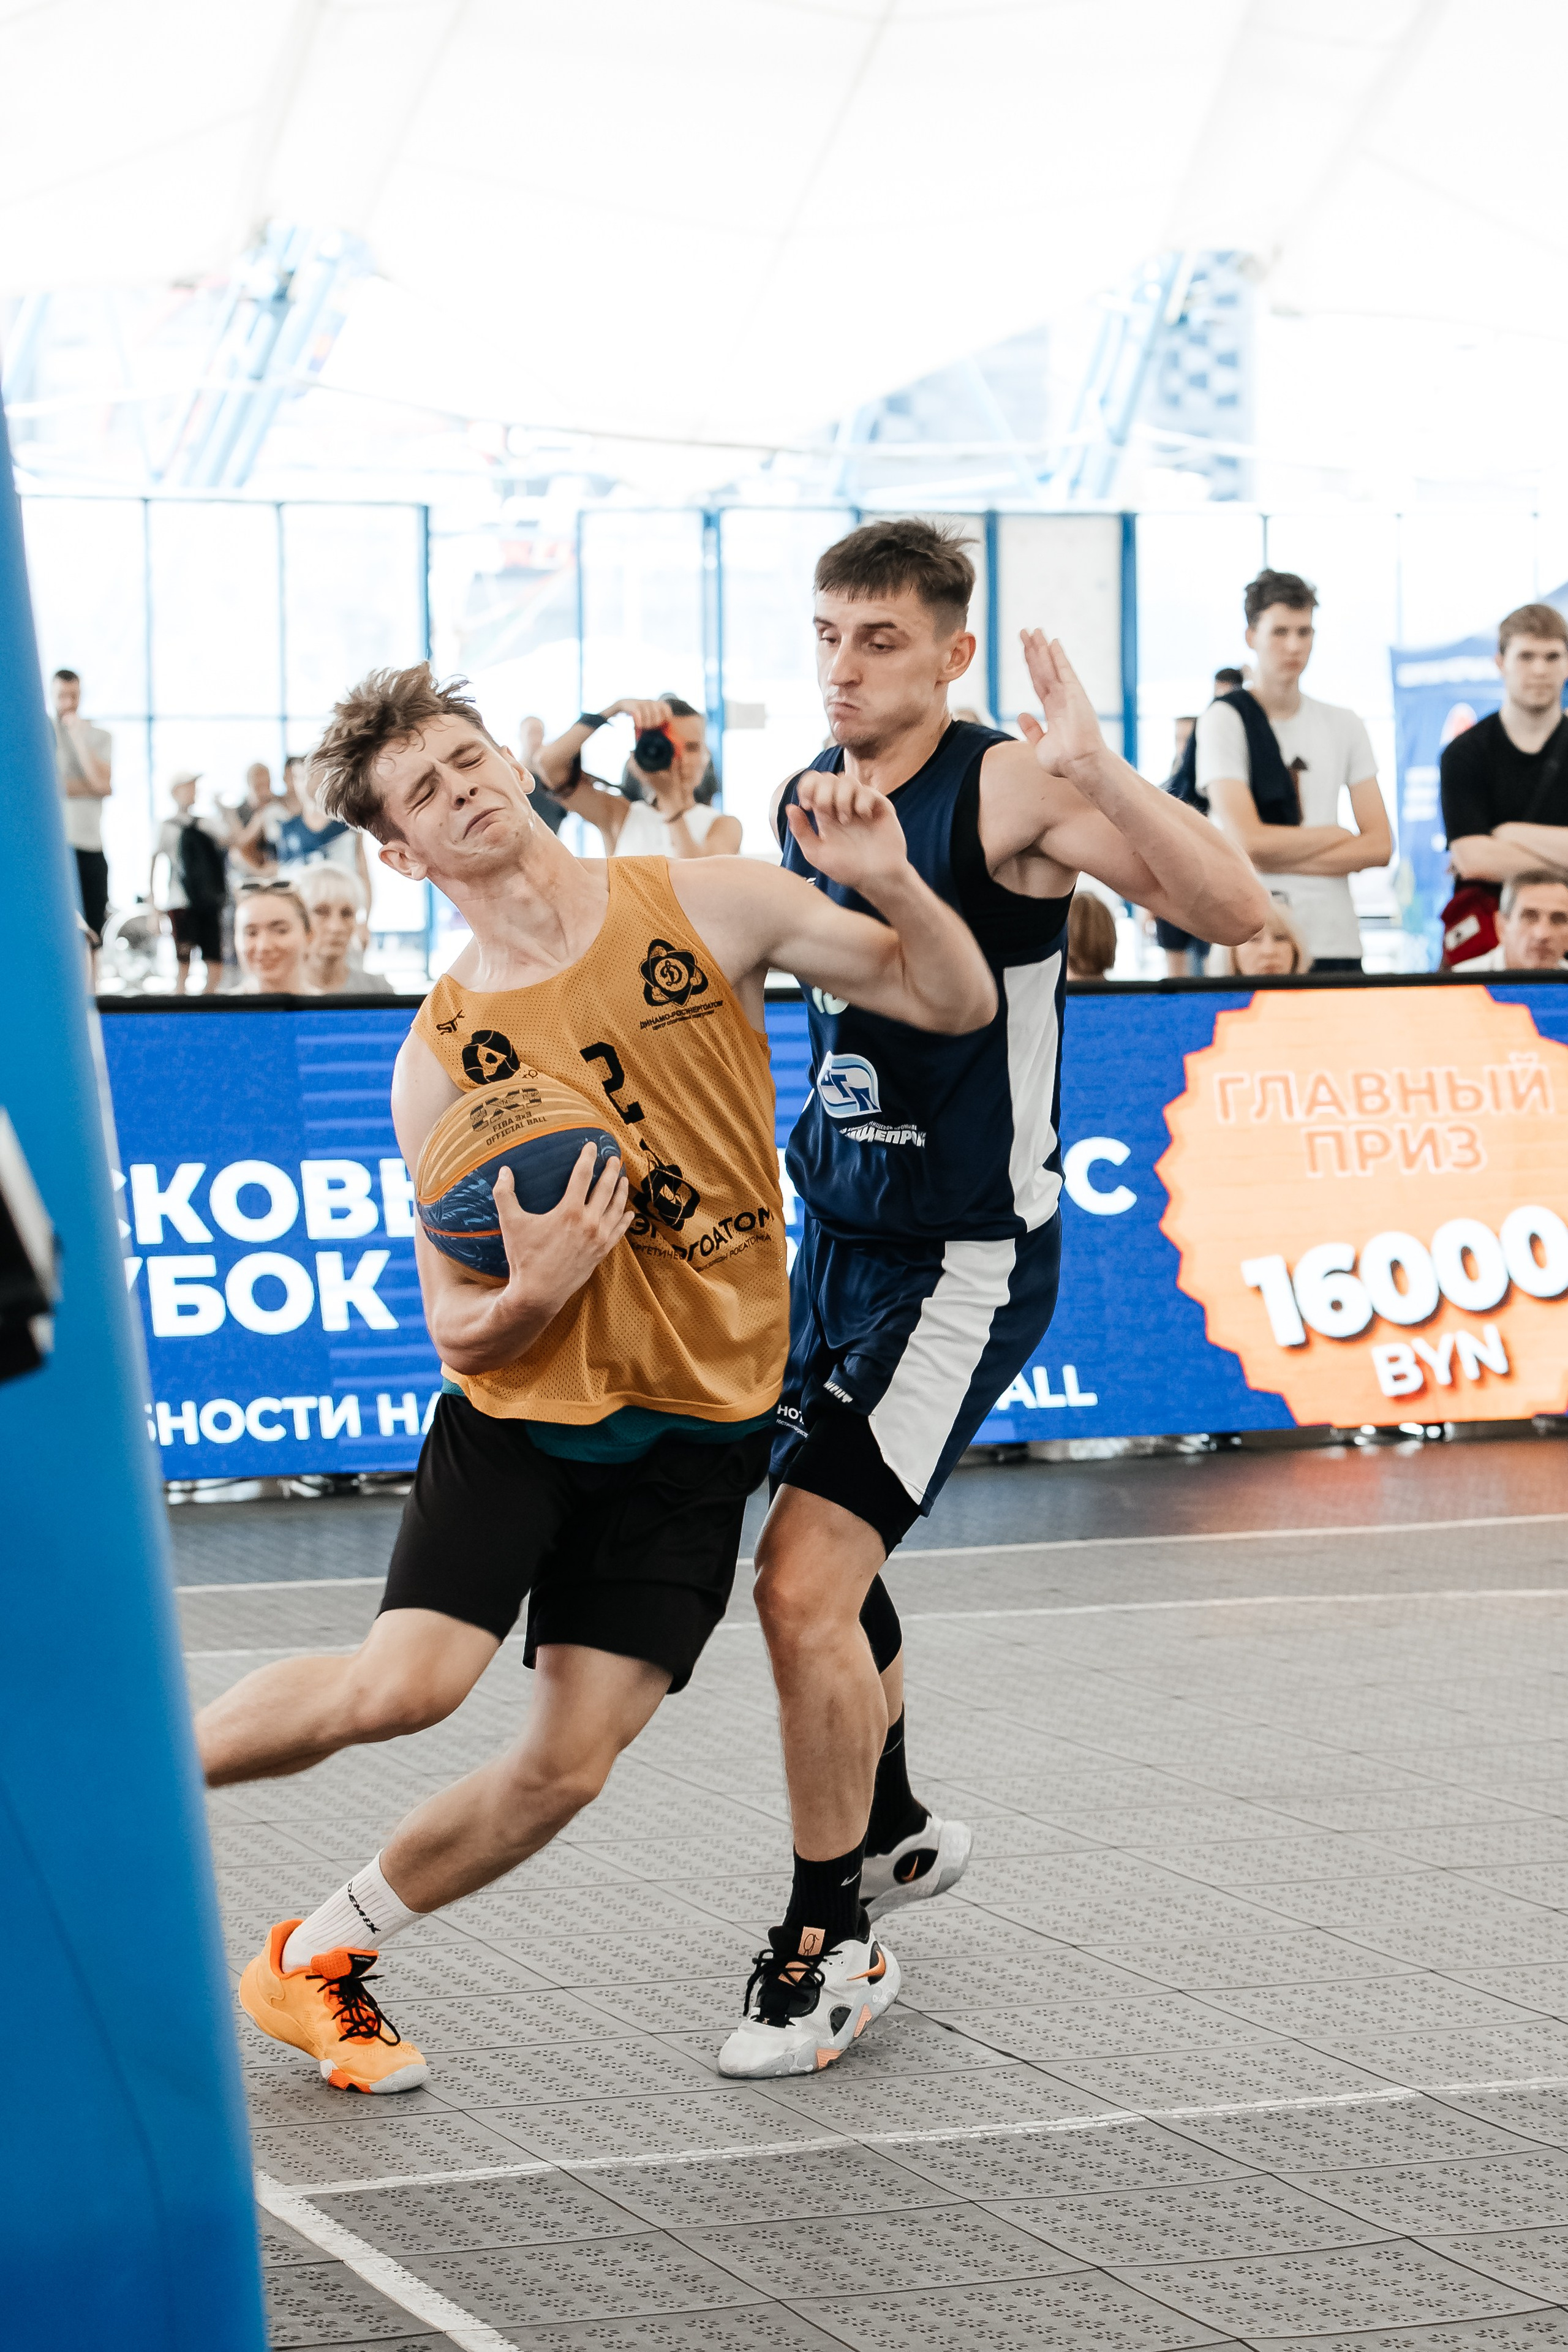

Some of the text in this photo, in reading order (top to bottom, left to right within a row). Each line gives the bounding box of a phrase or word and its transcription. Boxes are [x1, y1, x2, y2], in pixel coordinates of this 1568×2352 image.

[1215, 1052, 1553, 1123] ГЛАВНЫЙ
[1303, 1126, 1486, 1177] ПРИЗ
[1241, 1205, 1568, 1346] 16000
[1372, 1324, 1510, 1397] BYN
